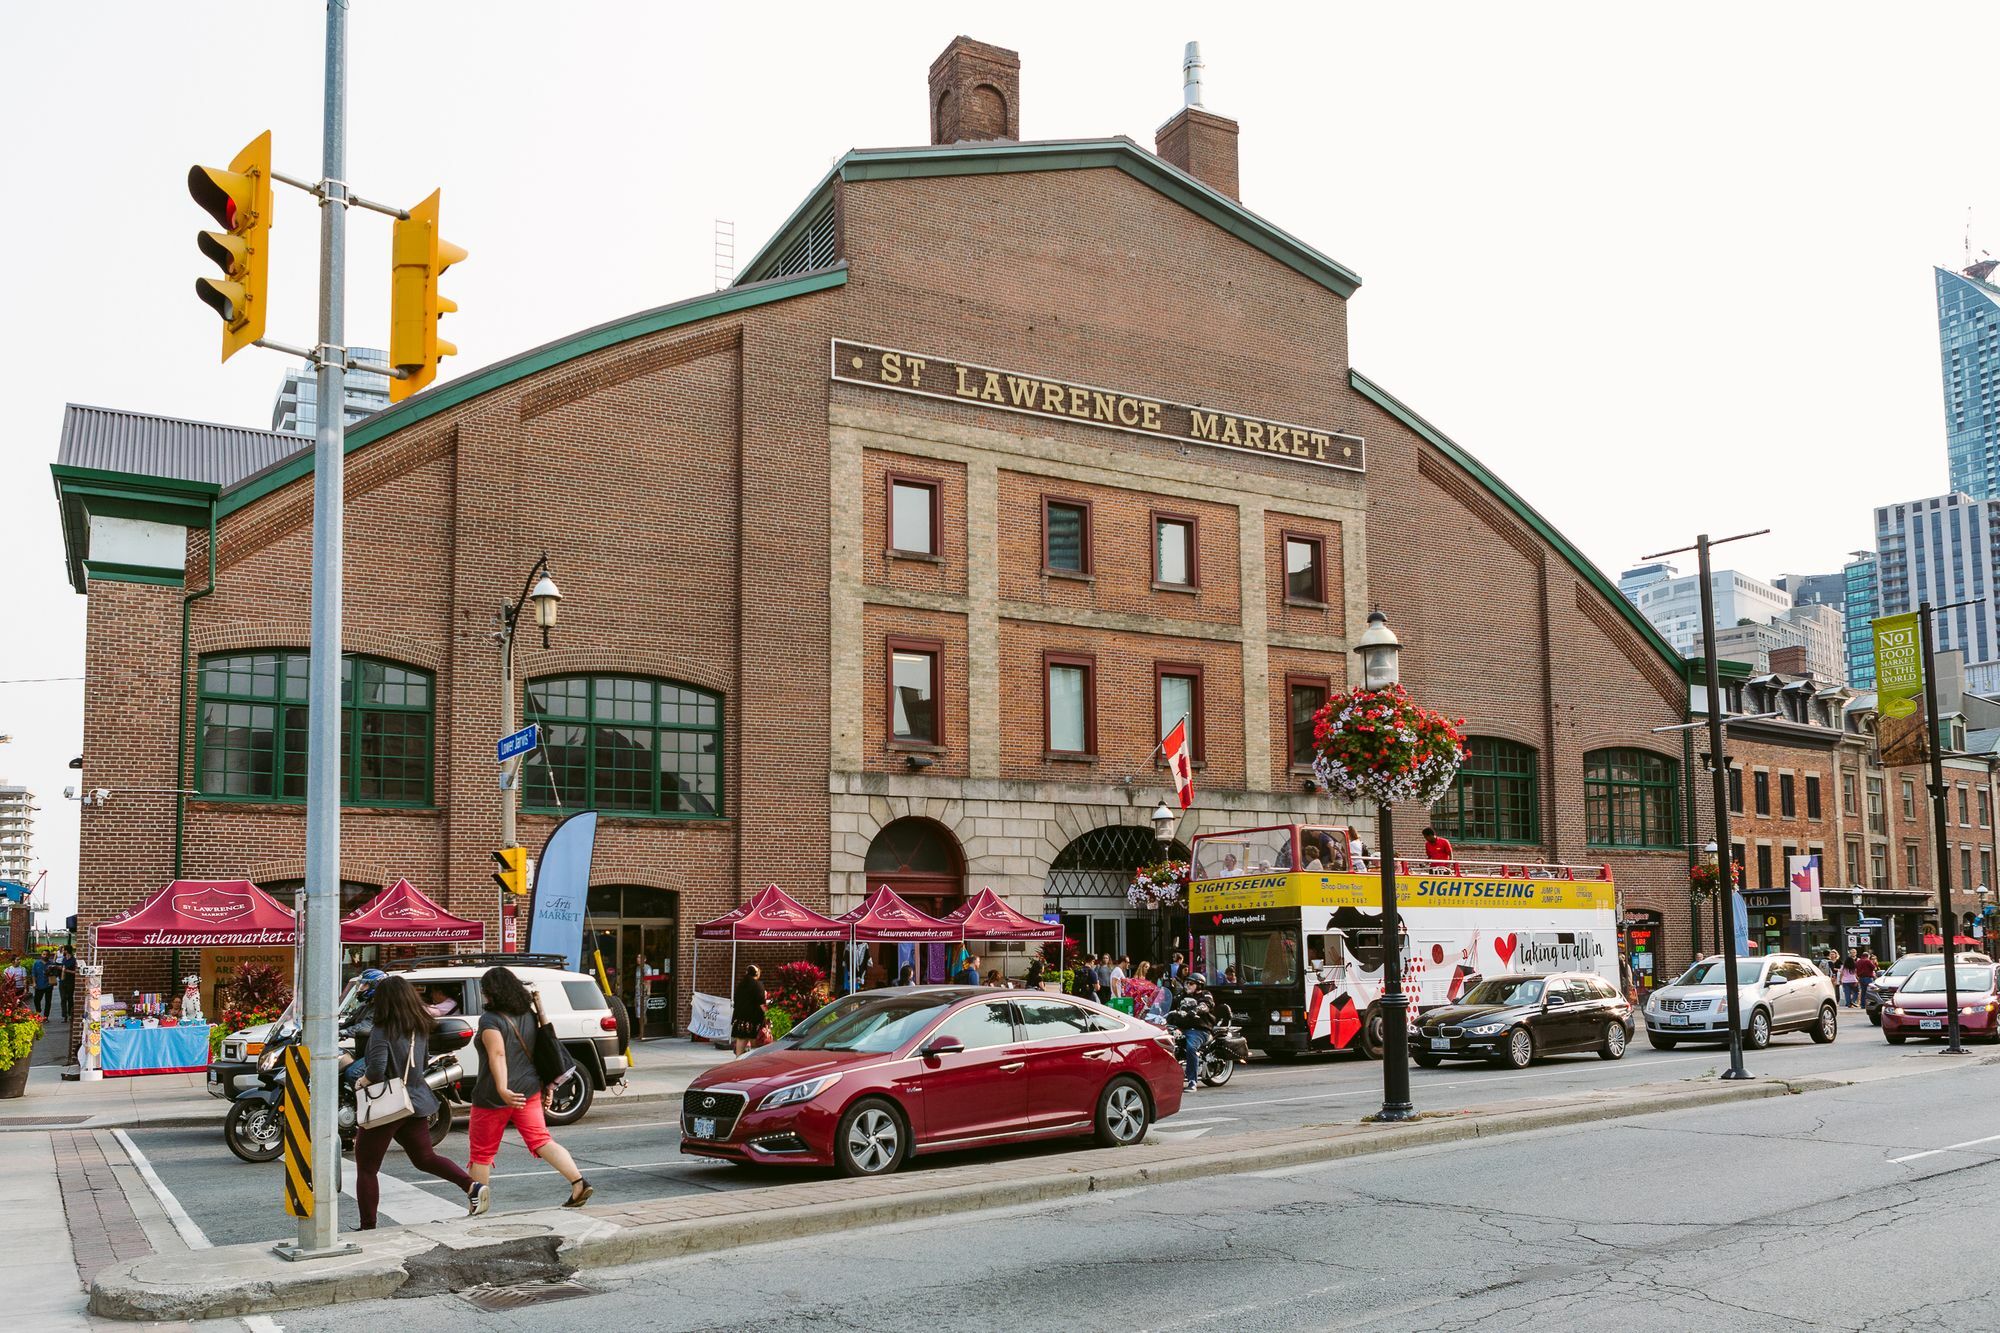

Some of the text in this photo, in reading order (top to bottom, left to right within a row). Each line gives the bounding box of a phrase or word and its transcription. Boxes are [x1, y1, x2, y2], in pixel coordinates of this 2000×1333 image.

[881, 353, 1330, 460] ST LAWRENCE MARKET
[1880, 647, 1915, 661] FOOD
[1880, 656, 1915, 668] MARKET
[1881, 666, 1916, 678] IN THE
[1881, 673, 1917, 685] WORLD
[501, 740, 514, 756] Lower
[515, 732, 529, 750] Jarvis
[1194, 877, 1288, 894] SIGHTSEEING
[1321, 883, 1335, 891] Shop
[1417, 880, 1535, 899] SIGHTSEEING
[1541, 886, 1561, 895] JUMP ON
[546, 898, 572, 909] Arts
[1541, 895, 1563, 904] JUMP OFF
[194, 904, 246, 912] LAWRENCE
[1203, 901, 1276, 911] 416.463.7467
[539, 910, 578, 922] MARKET
[1222, 916, 1246, 925] everything
[1247, 915, 1260, 923] about
[369, 927, 470, 938] stlawrencemarket.com
[758, 928, 841, 937] stlawrencemarket.com
[877, 928, 953, 938] stlawrencemarket.com
[216, 954, 285, 963] OUR PRODUCTS
[1520, 938, 1604, 970] taking it all in
[216, 966, 234, 974] ARE
